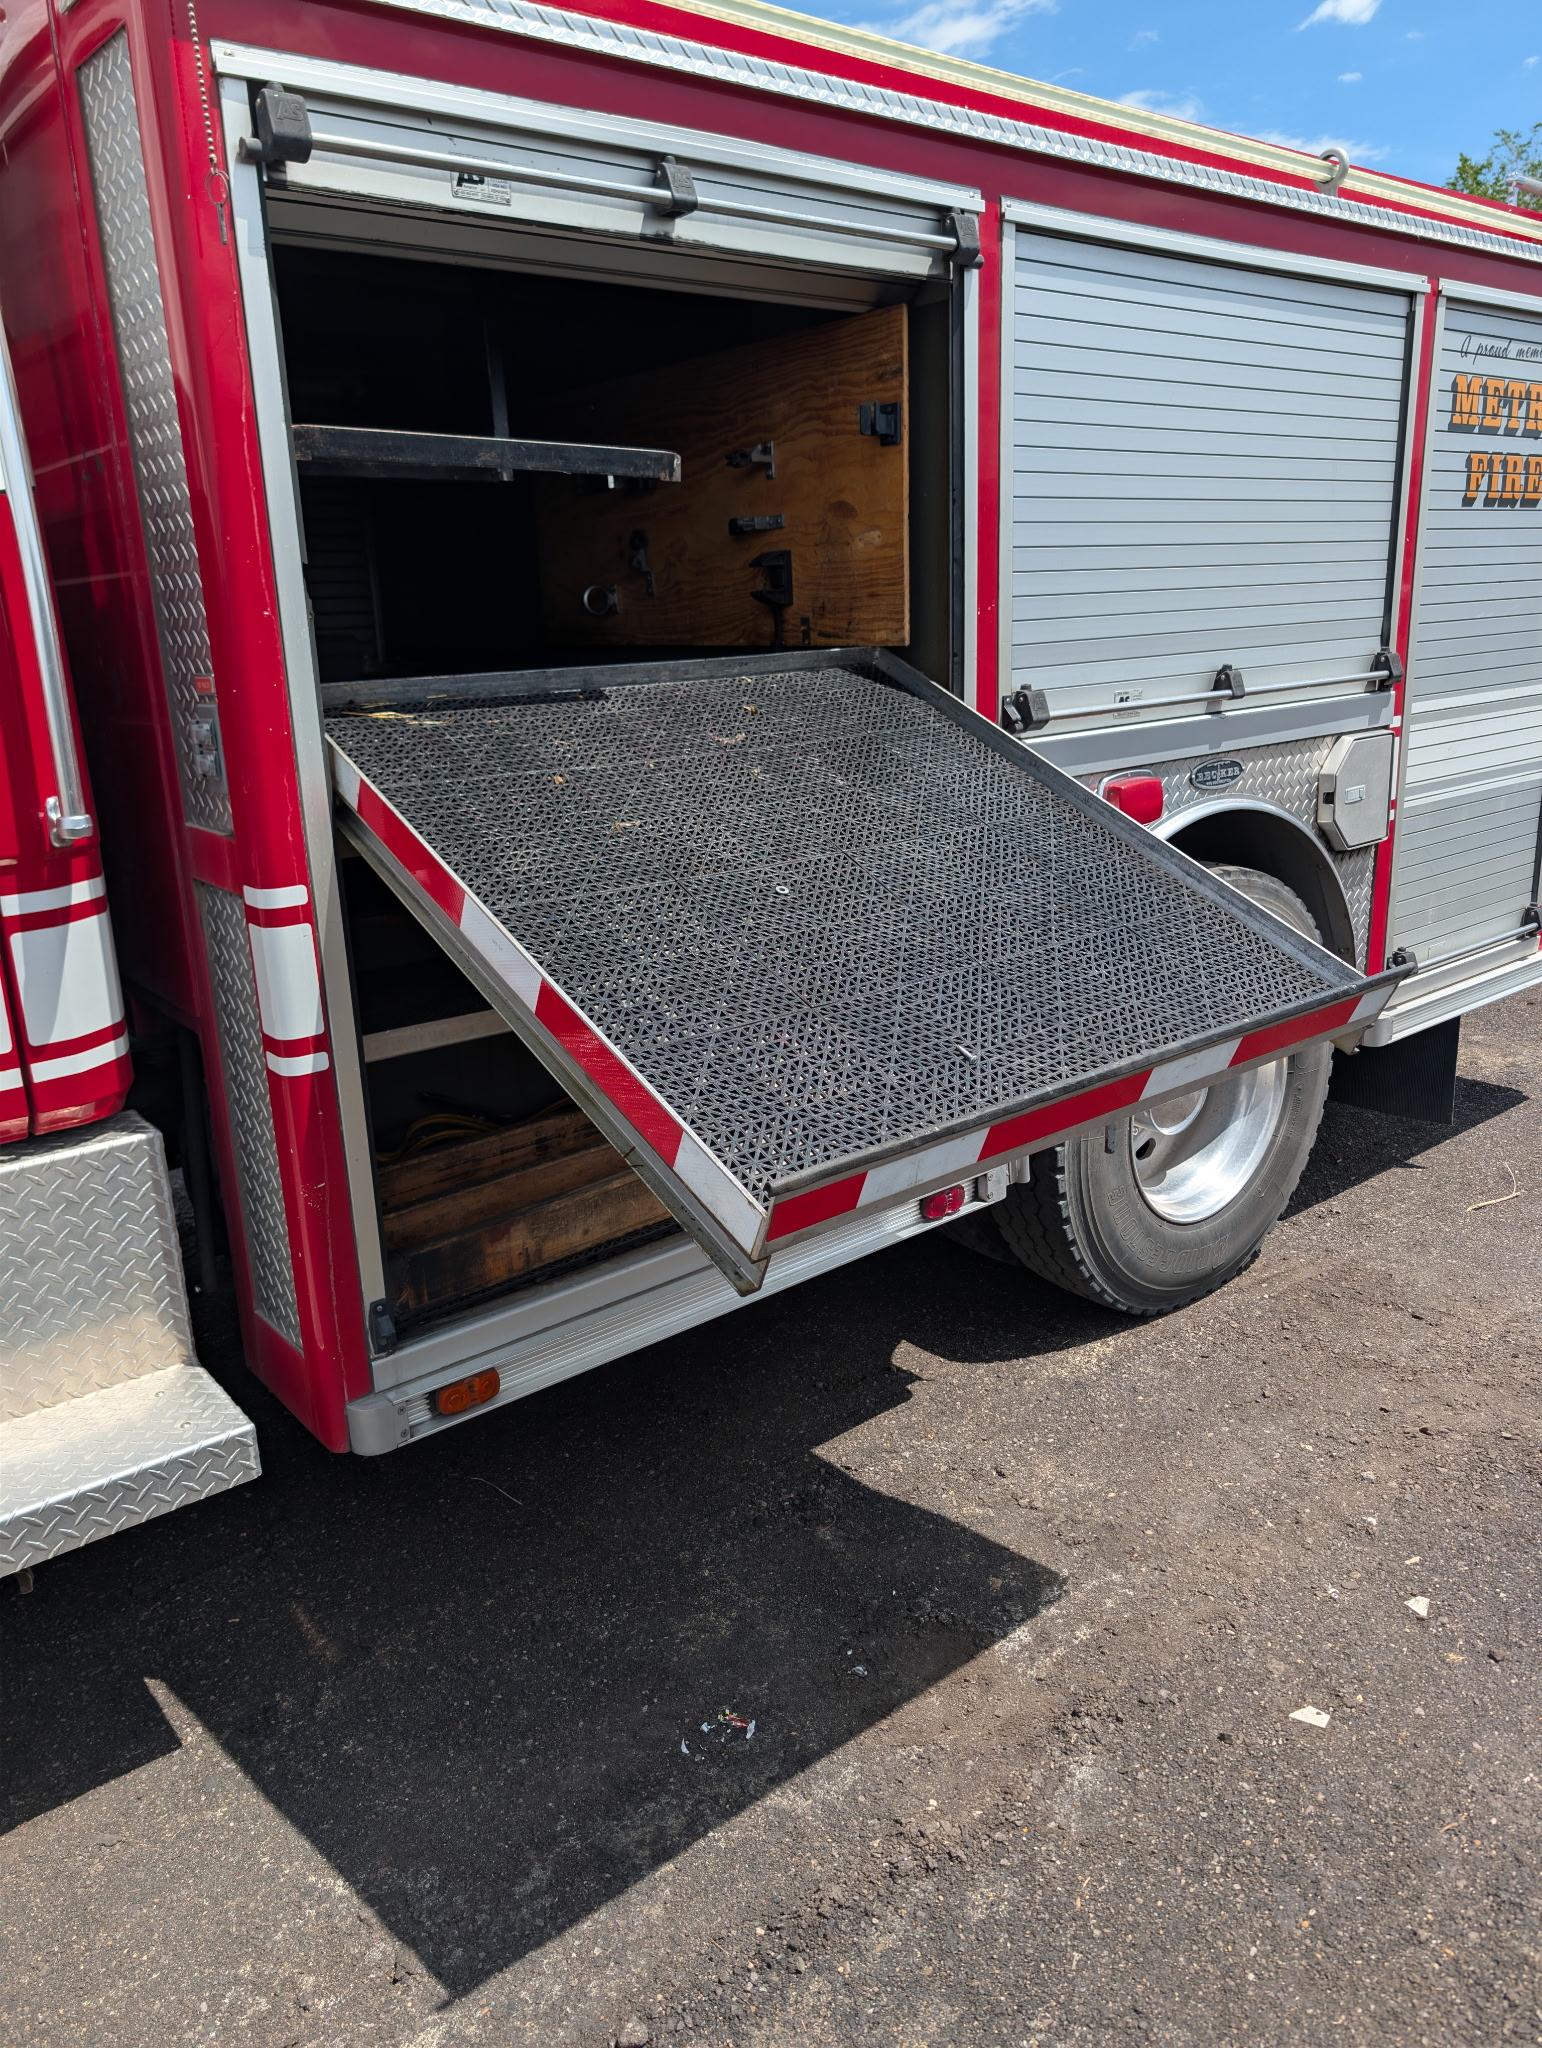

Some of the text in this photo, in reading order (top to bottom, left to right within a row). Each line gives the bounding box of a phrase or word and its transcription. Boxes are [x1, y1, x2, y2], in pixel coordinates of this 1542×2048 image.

[1460, 334, 1542, 365] A proud mem
[1461, 450, 1542, 508] FIRE
[1196, 766, 1240, 783] BECKER
[1106, 1185, 1230, 1274] BRIDGESTONE
